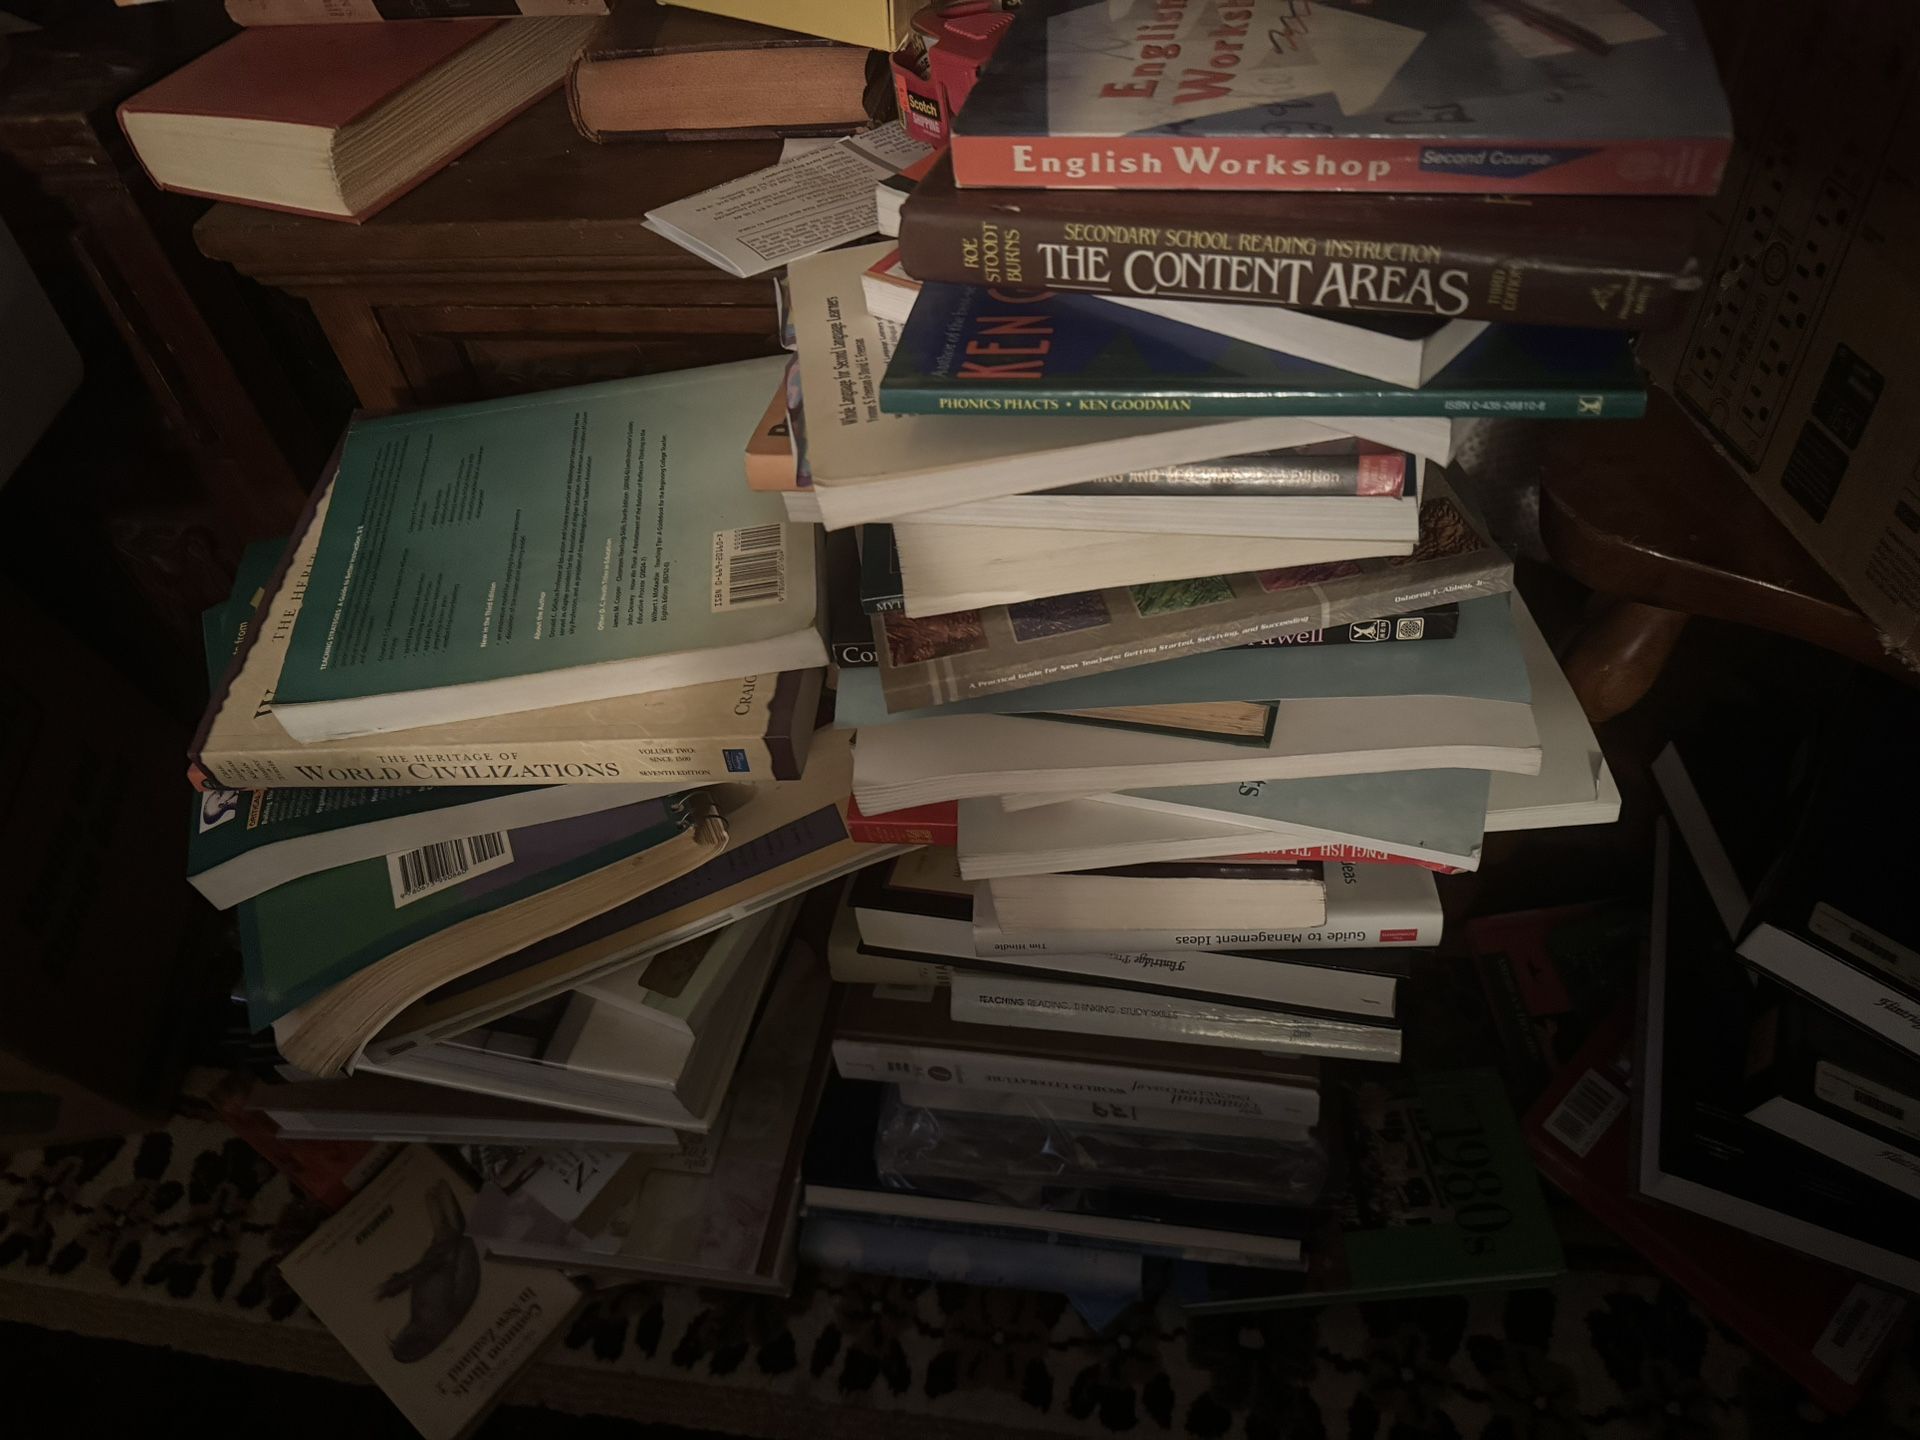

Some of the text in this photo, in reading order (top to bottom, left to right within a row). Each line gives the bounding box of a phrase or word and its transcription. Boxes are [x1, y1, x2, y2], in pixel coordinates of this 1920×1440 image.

[908, 94, 938, 118] Scotch
[1012, 145, 1390, 182] English Workshop
[1422, 150, 1552, 166] Second Course
[963, 237, 980, 268] ROE
[982, 221, 1001, 283] STOODT
[1064, 223, 1442, 264] SECONDARY SCHOOL READING INSTRUCTION
[1004, 229, 1022, 282] BURNS
[1037, 244, 1470, 316] THE CONTENT AREAS
[955, 315, 1056, 379] KEN
[825, 296, 859, 425] Whole Language for Second Language Learners
[939, 397, 1192, 412] PHONICS PHACTS KEN GOODMAN
[1445, 400, 1470, 410] ISBN
[660, 451, 668, 467] College
[659, 468, 668, 490] Beginning
[655, 546, 663, 568] Teaching
[486, 581, 497, 602] Edition
[597, 615, 606, 630] Other
[603, 538, 612, 563] Education
[614, 586, 622, 603] Cooper
[628, 594, 636, 614] Dewey
[637, 579, 647, 625] Educative Process
[714, 588, 723, 607] ISBN
[1394, 591, 1431, 603] Osborne
[484, 602, 494, 616] Third
[534, 592, 546, 640] About the Author
[612, 612, 620, 628] James
[651, 603, 659, 622] Wilbert
[661, 603, 669, 621] Eighth
[234, 621, 249, 643] from
[271, 607, 297, 642] THE
[483, 618, 492, 627] the
[480, 634, 489, 647] New
[1248, 628, 1325, 646] twell
[320, 641, 334, 670] TEACHING
[977, 675, 1017, 688] Practical
[1018, 669, 1043, 681] Guide
[1044, 665, 1058, 676] for
[1059, 661, 1080, 672] New
[1081, 654, 1123, 668] Teachers:
[1124, 645, 1158, 659] Getting
[1241, 625, 1260, 635] and
[1261, 614, 1310, 631] Succeeding
[734, 675, 757, 716] CRAIG
[377, 751, 521, 764] THE HERITAGE OF
[638, 747, 674, 755] VOLUME
[295, 759, 621, 784] WORLD CIVILIZATIONS
[639, 768, 712, 777] SEVENTH EDITION
[994, 942, 1047, 952] Tim Hindle
[1175, 930, 1366, 947] Guide to Management Ideas
[979, 995, 1024, 1006] TEACHING
[1120, 1006, 1150, 1017] STUDY
[1442, 1118, 1513, 1258] 1980s
